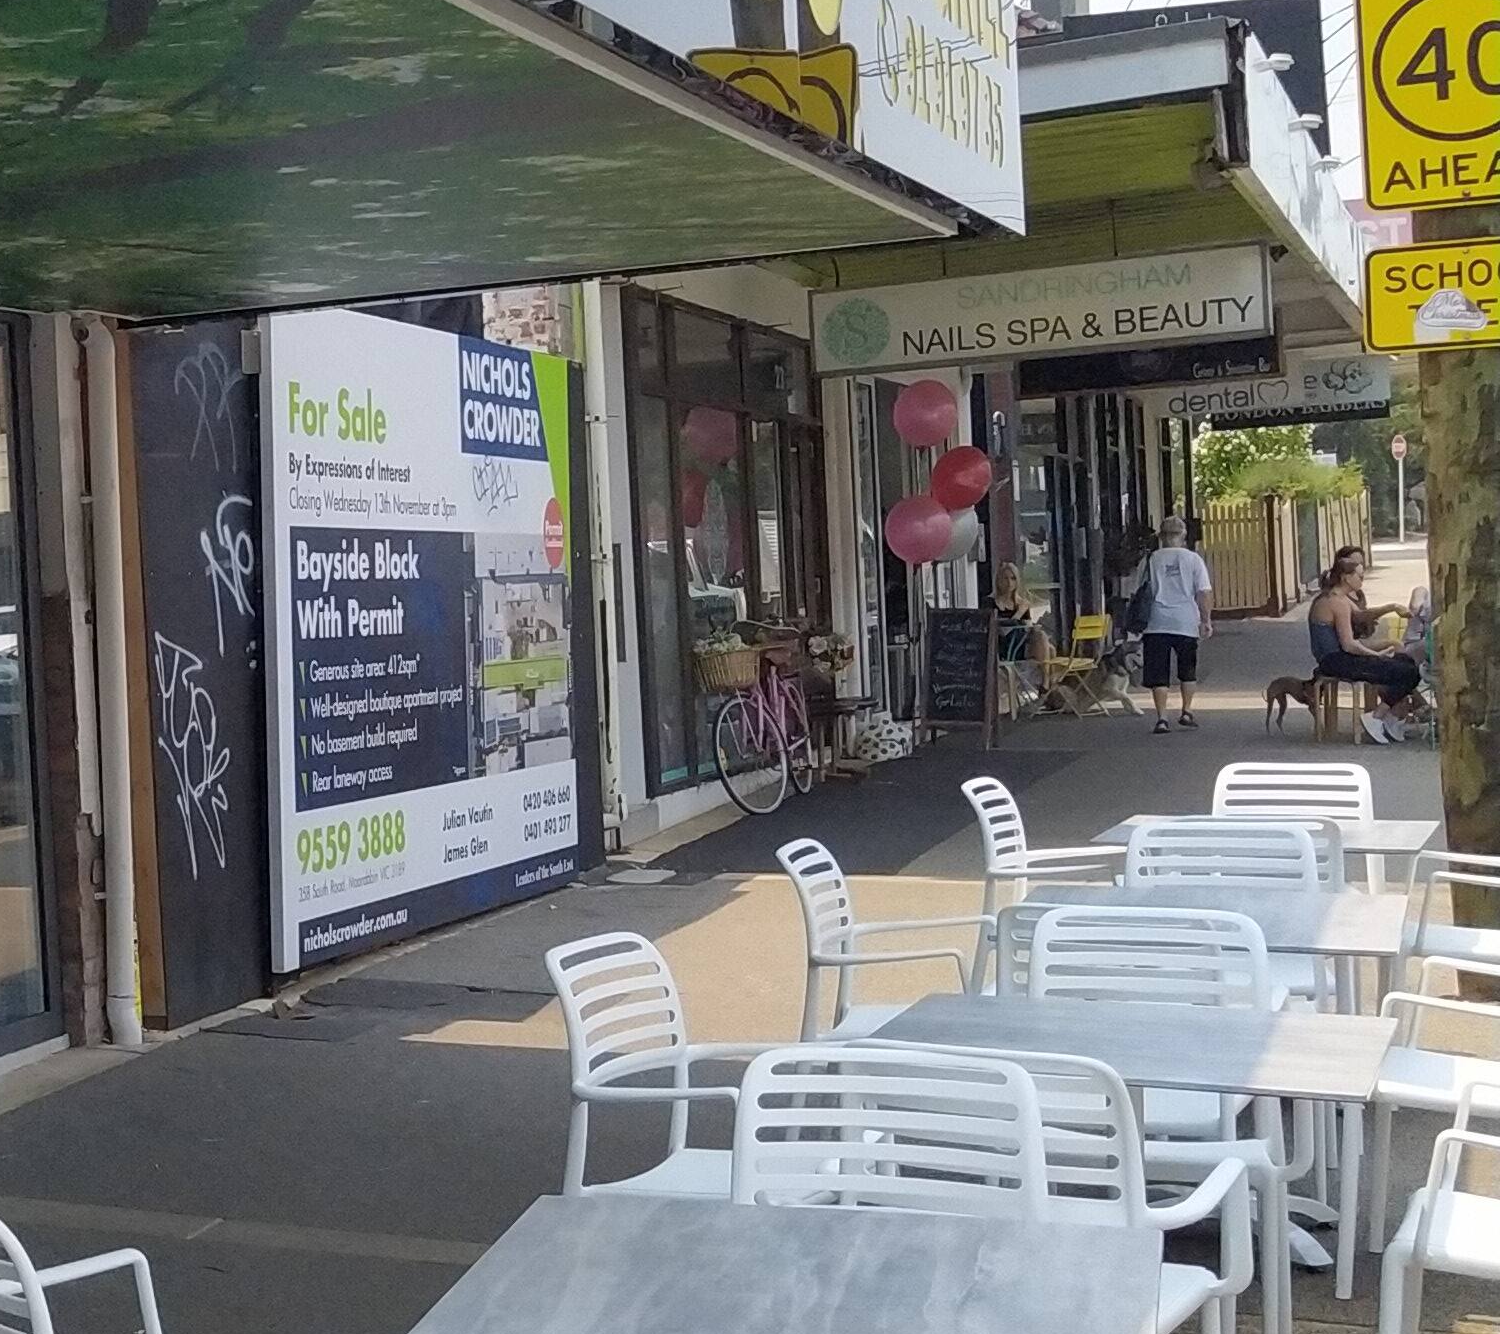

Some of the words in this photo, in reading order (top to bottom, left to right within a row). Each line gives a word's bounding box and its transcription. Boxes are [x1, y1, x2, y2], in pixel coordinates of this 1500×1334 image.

[956, 263, 1193, 310] SANDRINGHAM
[1384, 259, 1500, 294] SCHO
[901, 322, 997, 356] NAILS
[1006, 315, 1073, 347] SPA
[1081, 312, 1104, 338] &
[1113, 295, 1256, 336] BEAUTY
[461, 349, 532, 402] NICHOLS
[288, 381, 329, 437] For
[337, 387, 388, 445] Sale
[1168, 382, 1256, 416] dental
[463, 398, 542, 448] CROWDER
[288, 452, 302, 481] By
[305, 454, 363, 483] Expressions
[365, 458, 376, 481] of
[378, 460, 411, 483] Interest
[289, 487, 322, 517] Closing
[323, 489, 372, 519] Wednesday
[374, 491, 391, 515] 13th
[393, 493, 431, 517] November
[432, 500, 440, 517] at
[441, 497, 457, 521] 3pm
[296, 537, 370, 593] Bayside
[374, 538, 420, 580] Block
[296, 595, 343, 640] With
[347, 594, 404, 637] Permit
[309, 659, 350, 682] Generous
[350, 657, 364, 678] site
[365, 662, 386, 677] area:
[310, 689, 369, 721] Well-designed
[369, 688, 403, 716] boutique
[403, 687, 439, 714] apartment
[439, 684, 463, 709] project
[311, 734, 325, 756] No
[326, 729, 365, 753] basement
[366, 722, 386, 748] build
[387, 717, 418, 751] required
[312, 770, 332, 793] Rear
[333, 765, 367, 791] laneway
[368, 765, 393, 781] access
[442, 808, 467, 832] Julian
[523, 791, 542, 813] 0420
[296, 820, 351, 875] 9559
[357, 809, 406, 862] 3888
[443, 842, 469, 864] James
[470, 835, 489, 856] Glen
[303, 908, 409, 953] nicholscrowder.com.au
